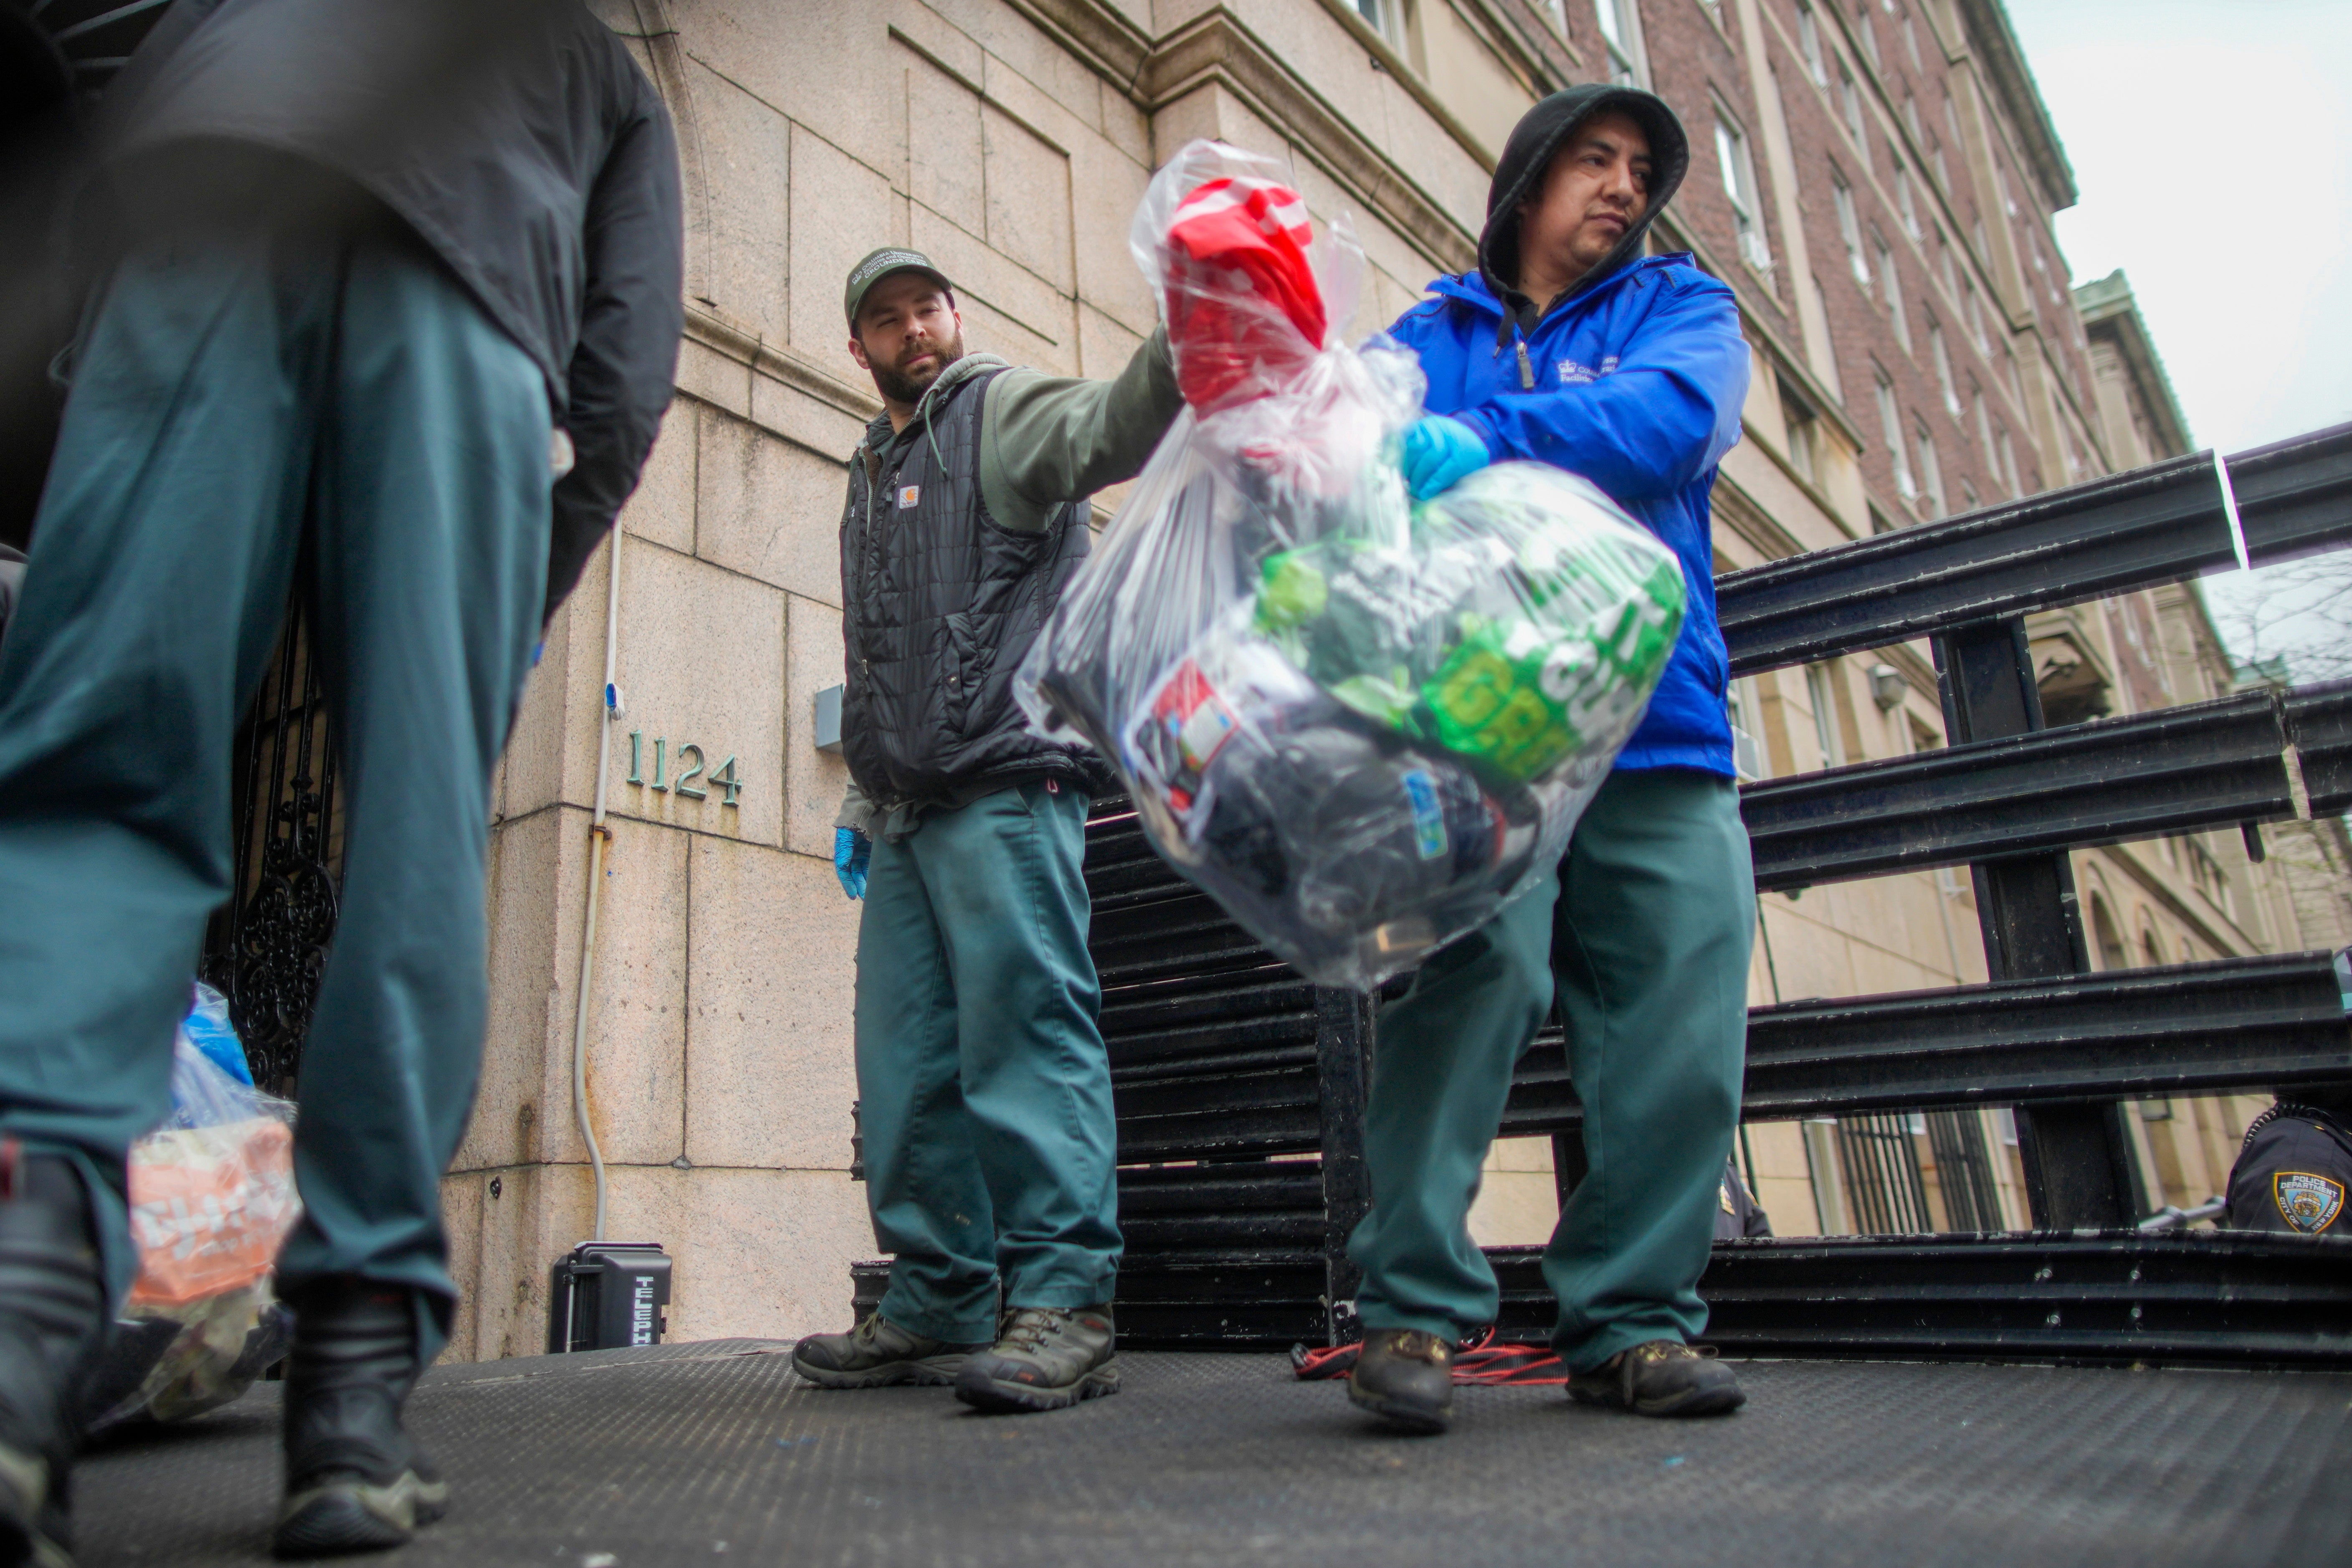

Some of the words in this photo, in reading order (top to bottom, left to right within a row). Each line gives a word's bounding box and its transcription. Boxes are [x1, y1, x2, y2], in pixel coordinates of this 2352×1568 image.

[862, 252, 890, 271] COLUMBIA
[890, 251, 923, 259] UNIVERSITY
[865, 258, 904, 278] GROUNDS
[627, 729, 742, 807] 1124
[2280, 1182, 2338, 1198] DEPARTMENT
[2292, 1175, 2327, 1187] POLICE
[2279, 1197, 2291, 1213] CITY
[2289, 1215, 2300, 1226] OF
[2311, 1218, 2327, 1231] NEW
[2324, 1201, 2339, 1218] YORK
[632, 1276, 654, 1346] TELEPH
